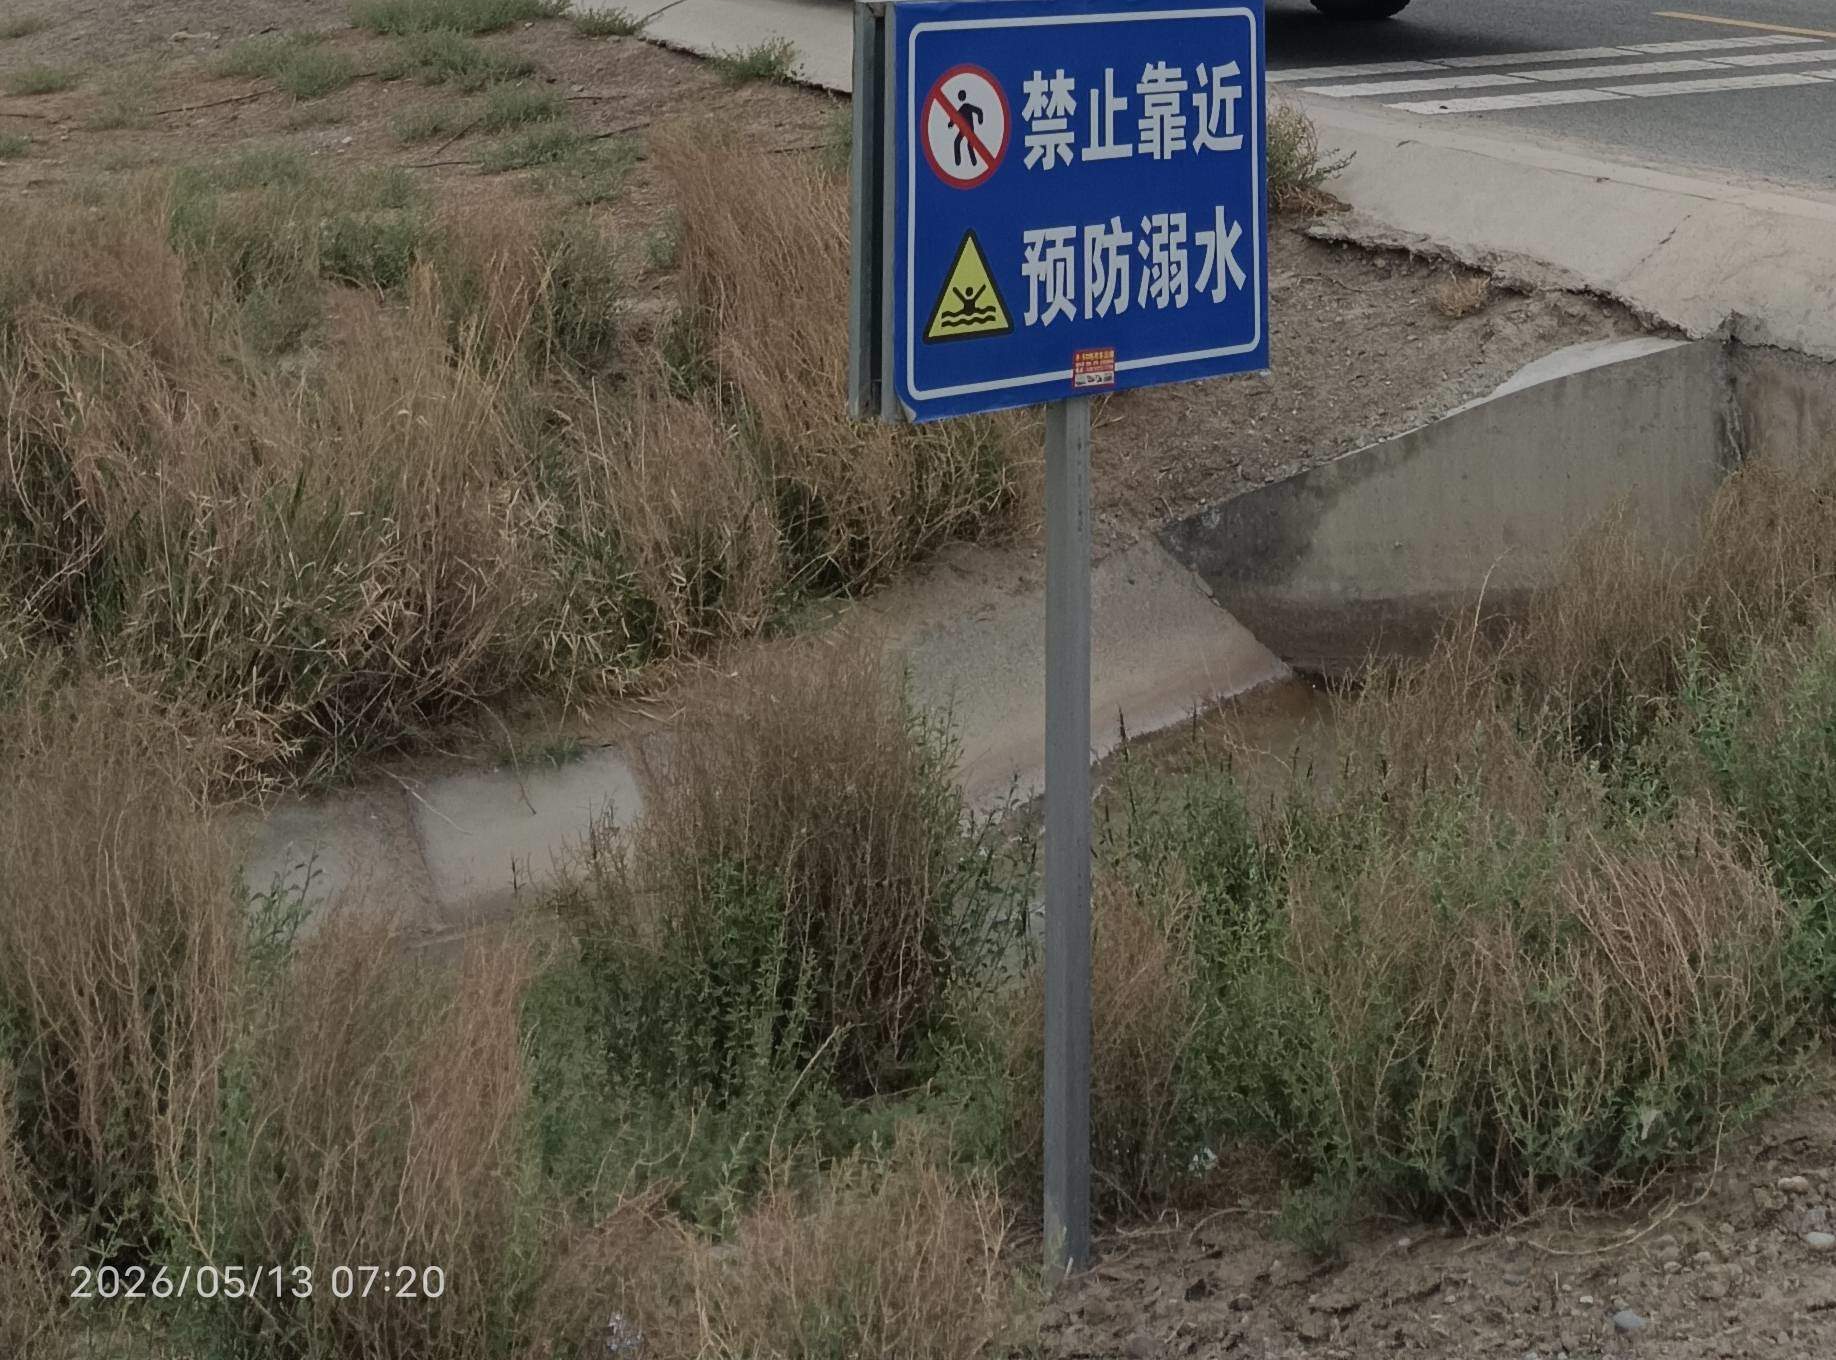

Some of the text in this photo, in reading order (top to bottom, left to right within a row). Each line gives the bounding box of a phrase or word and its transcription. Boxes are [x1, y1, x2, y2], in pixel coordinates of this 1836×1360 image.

[1022, 59, 1244, 171] 禁止靠近
[1021, 205, 1247, 327] 预防溺水
